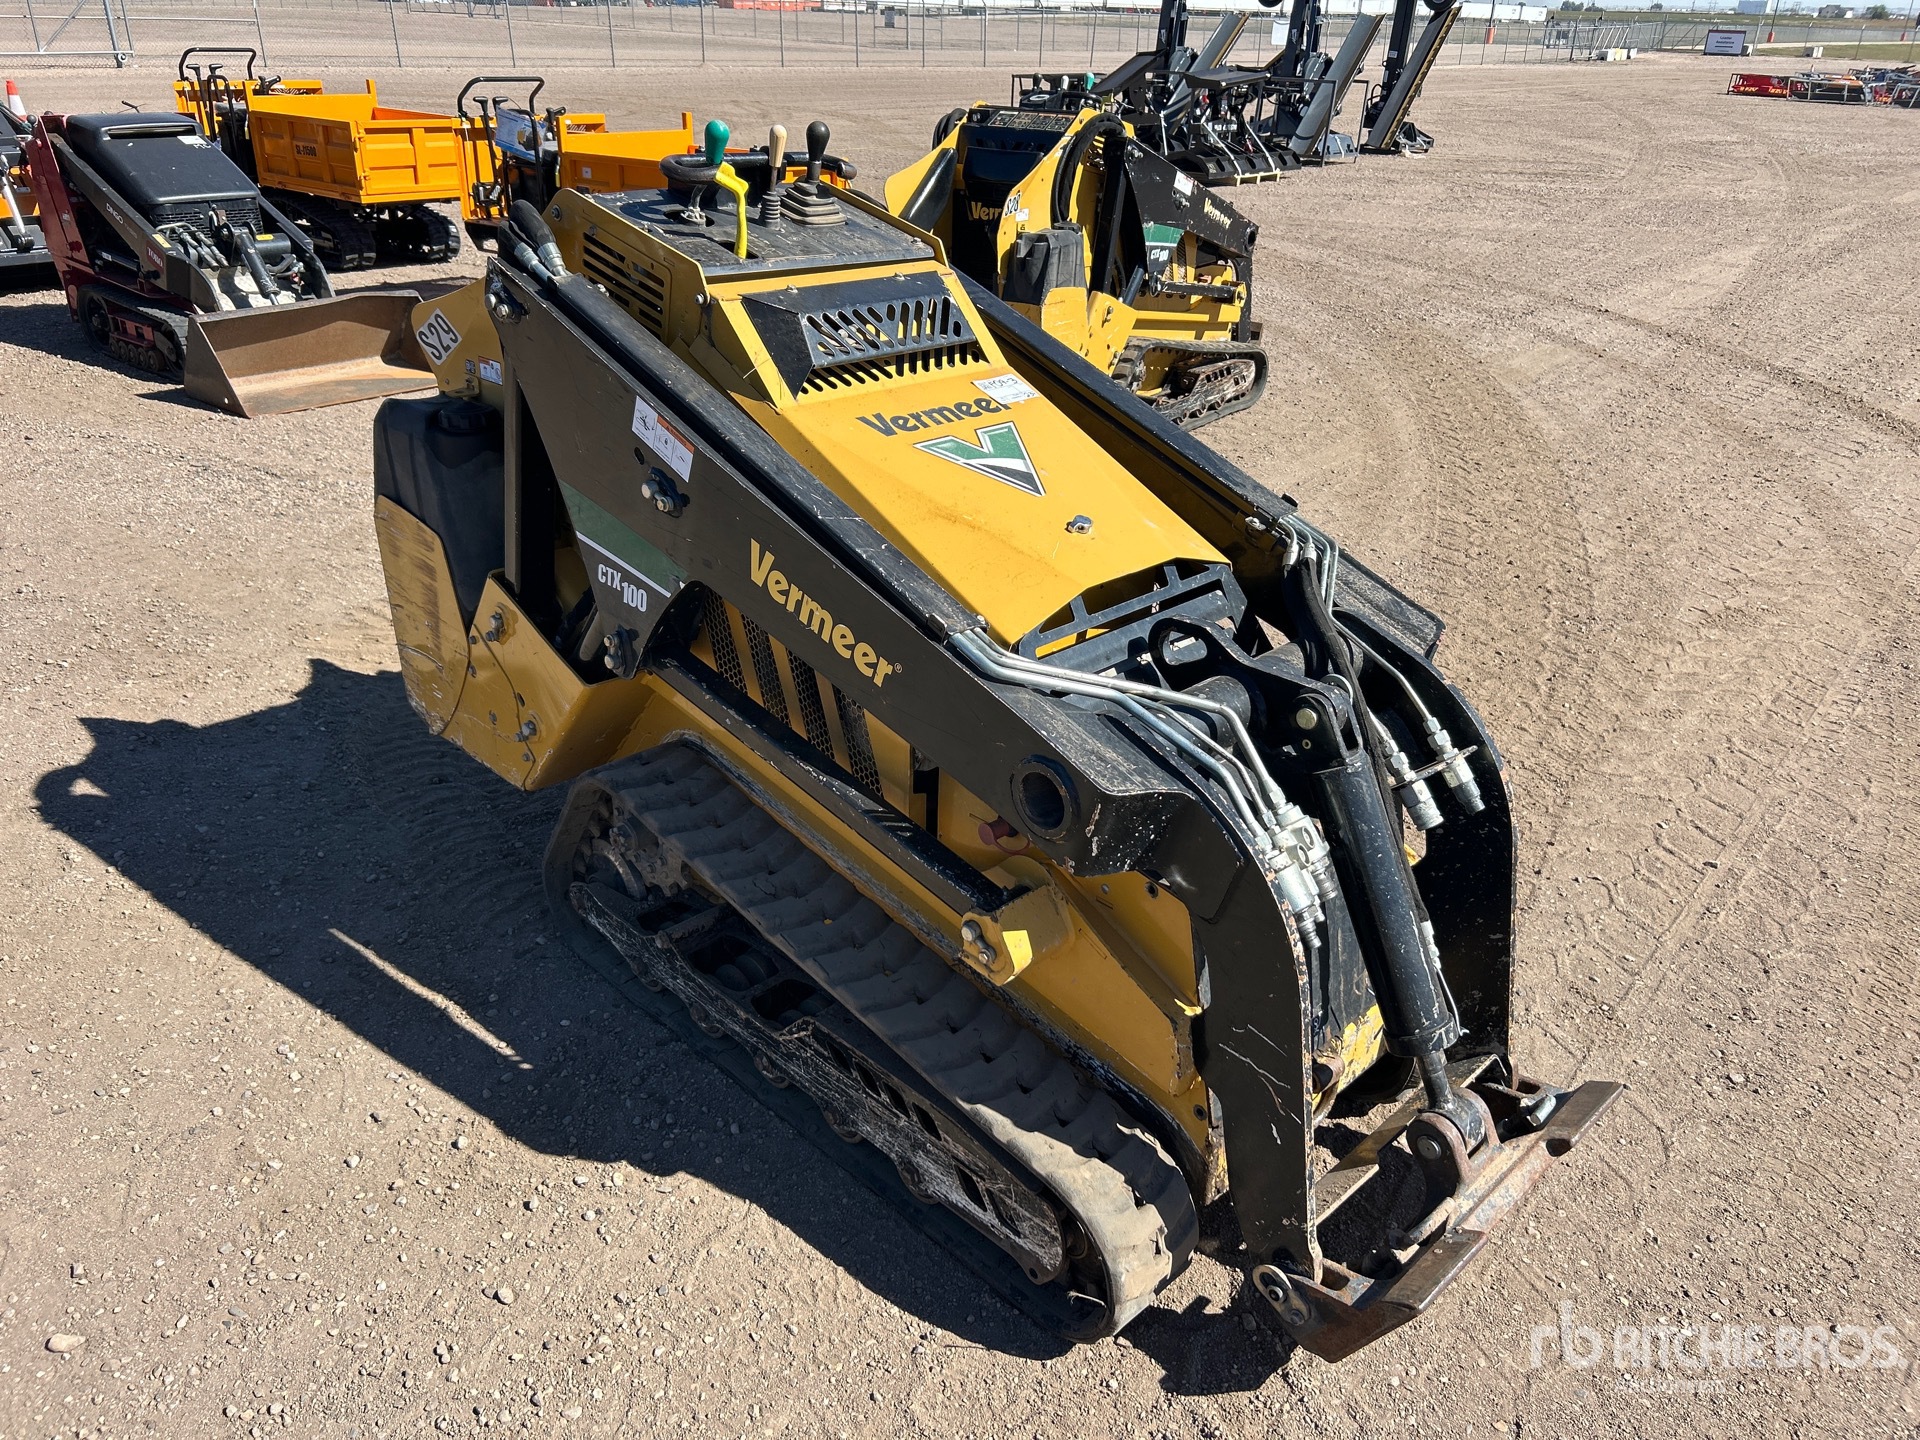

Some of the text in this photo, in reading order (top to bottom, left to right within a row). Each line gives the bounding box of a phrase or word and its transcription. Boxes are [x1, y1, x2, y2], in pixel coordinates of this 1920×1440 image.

[106, 203, 123, 224] DINGO
[1204, 197, 1232, 229] Vermeer
[418, 313, 459, 361] S29
